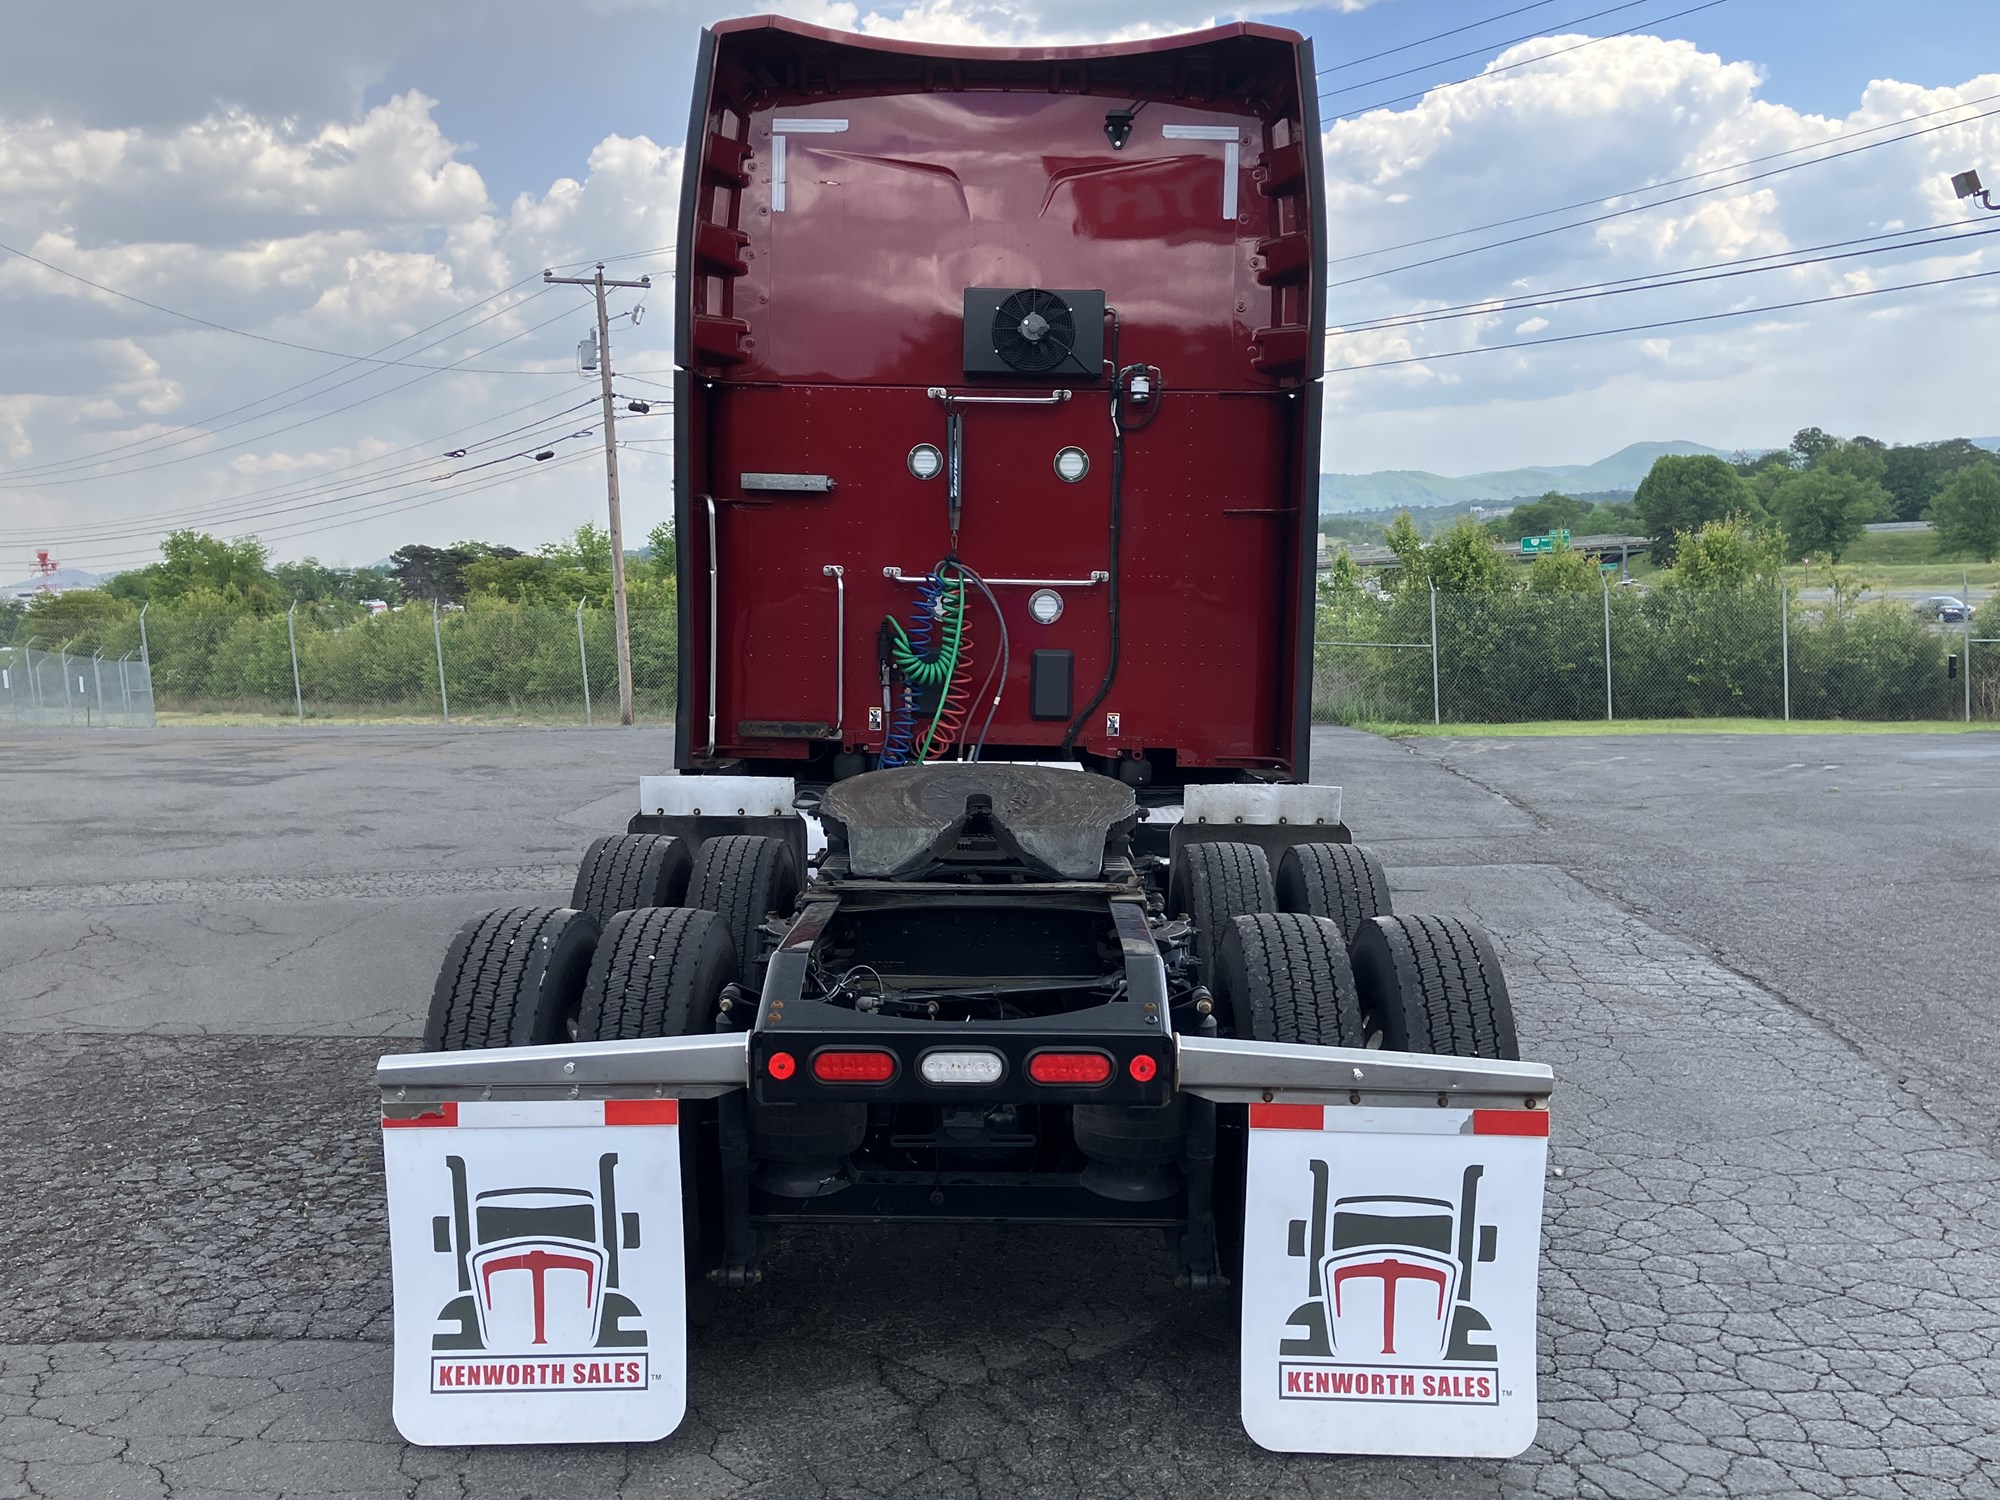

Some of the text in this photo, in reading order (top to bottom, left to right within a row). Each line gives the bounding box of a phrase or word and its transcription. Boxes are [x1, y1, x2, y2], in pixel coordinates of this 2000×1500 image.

[439, 1364, 565, 1386] KENWORTH
[573, 1362, 640, 1384] SALES
[1287, 1372, 1415, 1395] KENWORTH
[1423, 1375, 1490, 1398] SALES
